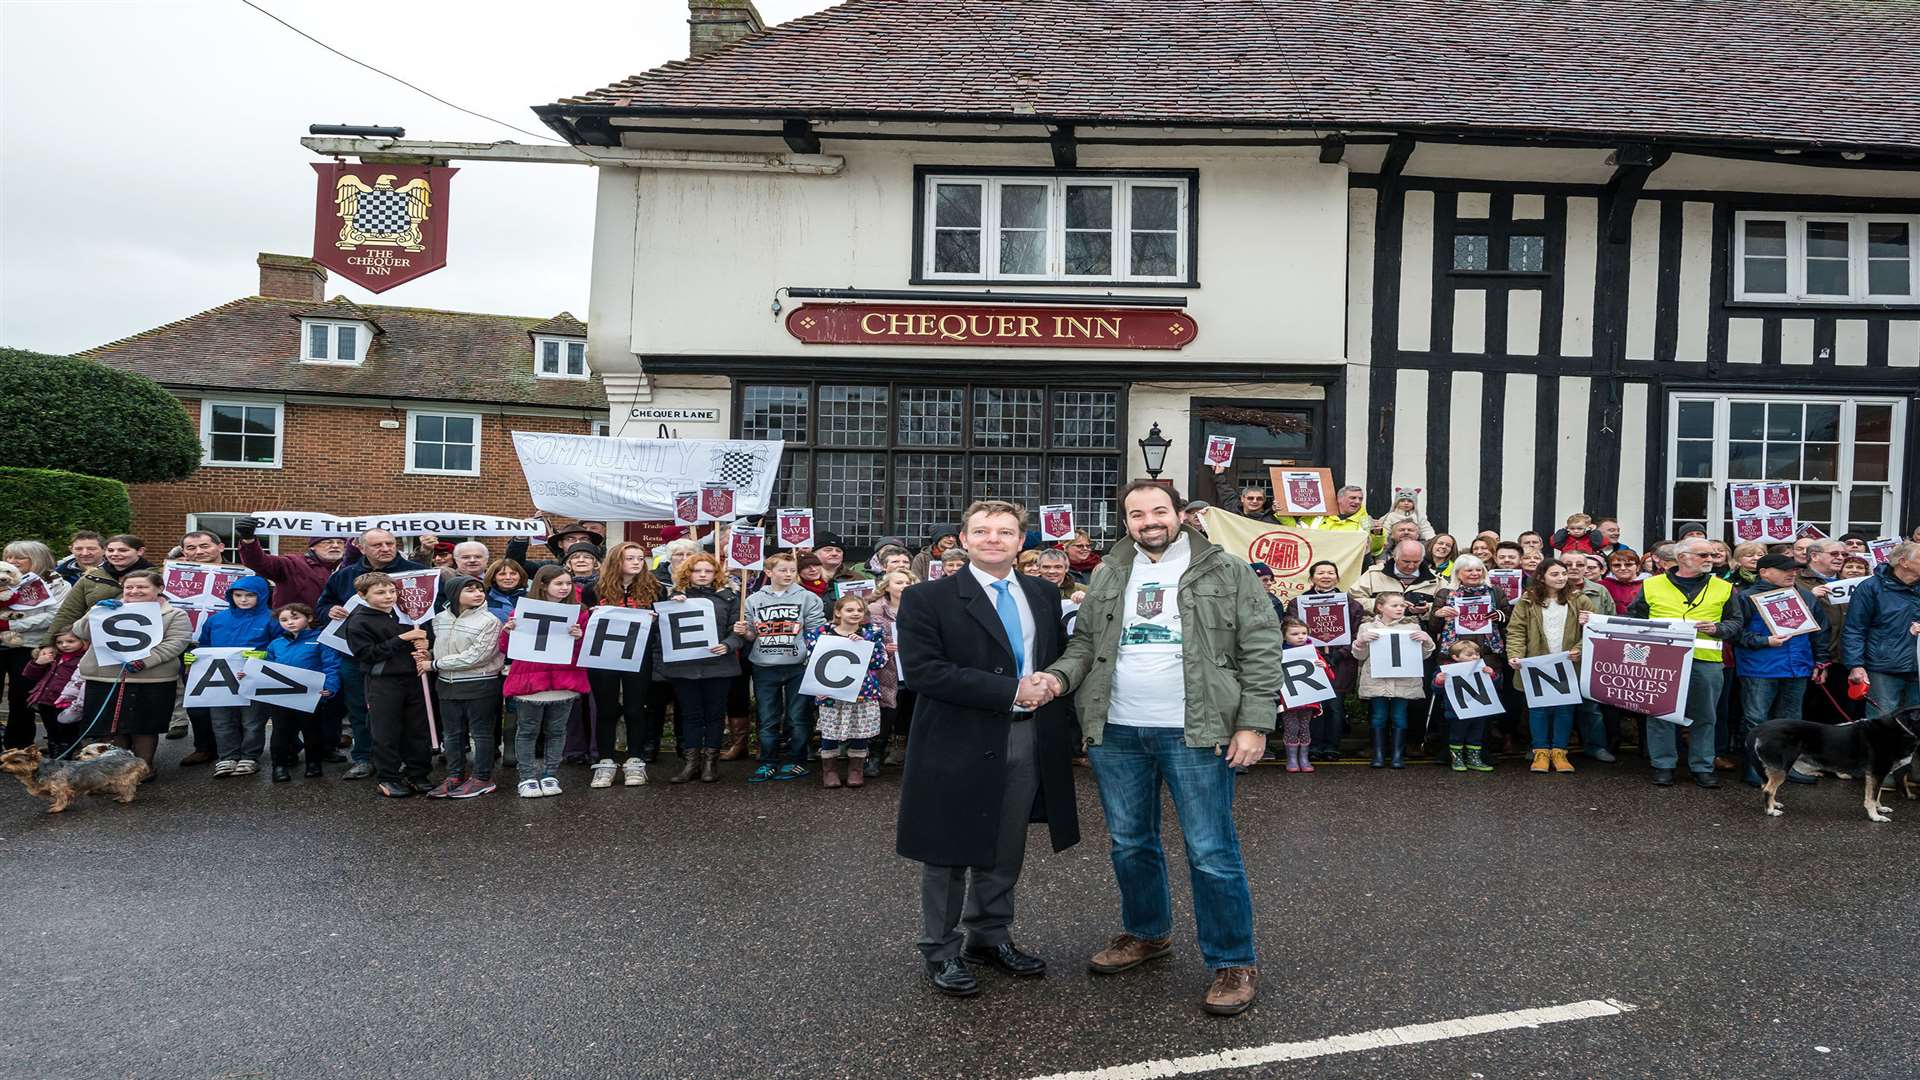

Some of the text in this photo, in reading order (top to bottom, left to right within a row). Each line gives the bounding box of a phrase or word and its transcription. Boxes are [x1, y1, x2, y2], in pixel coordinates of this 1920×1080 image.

[347, 257, 411, 267] CHEQUER
[366, 249, 394, 258] THE
[366, 266, 391, 275] INN
[861, 312, 1122, 340] CHEQUER INN
[631, 408, 713, 419] CHEQUER LANE
[518, 434, 701, 475] COMMUNITY
[255, 516, 539, 533] SAVE THE CHEQUER INN
[782, 526, 809, 535] SAVE
[1255, 538, 1299, 569] CAMRA
[168, 580, 203, 590] SAVE
[758, 606, 800, 621] VANS
[1137, 601, 1162, 610] SAVE
[1772, 608, 1803, 621] SAVE
[102, 613, 153, 653] S
[523, 611, 569, 652] T
[590, 618, 640, 659] H
[668, 610, 708, 650] E
[1390, 633, 1401, 668] I
[189, 658, 241, 696] A
[814, 649, 861, 688] C
[1281, 659, 1328, 697] R
[1527, 662, 1570, 697] N
[1594, 661, 1677, 682] COMMUNITY
[1452, 671, 1492, 709] N
[1599, 674, 1668, 694] COMES
[1606, 687, 1659, 705] FIRST
